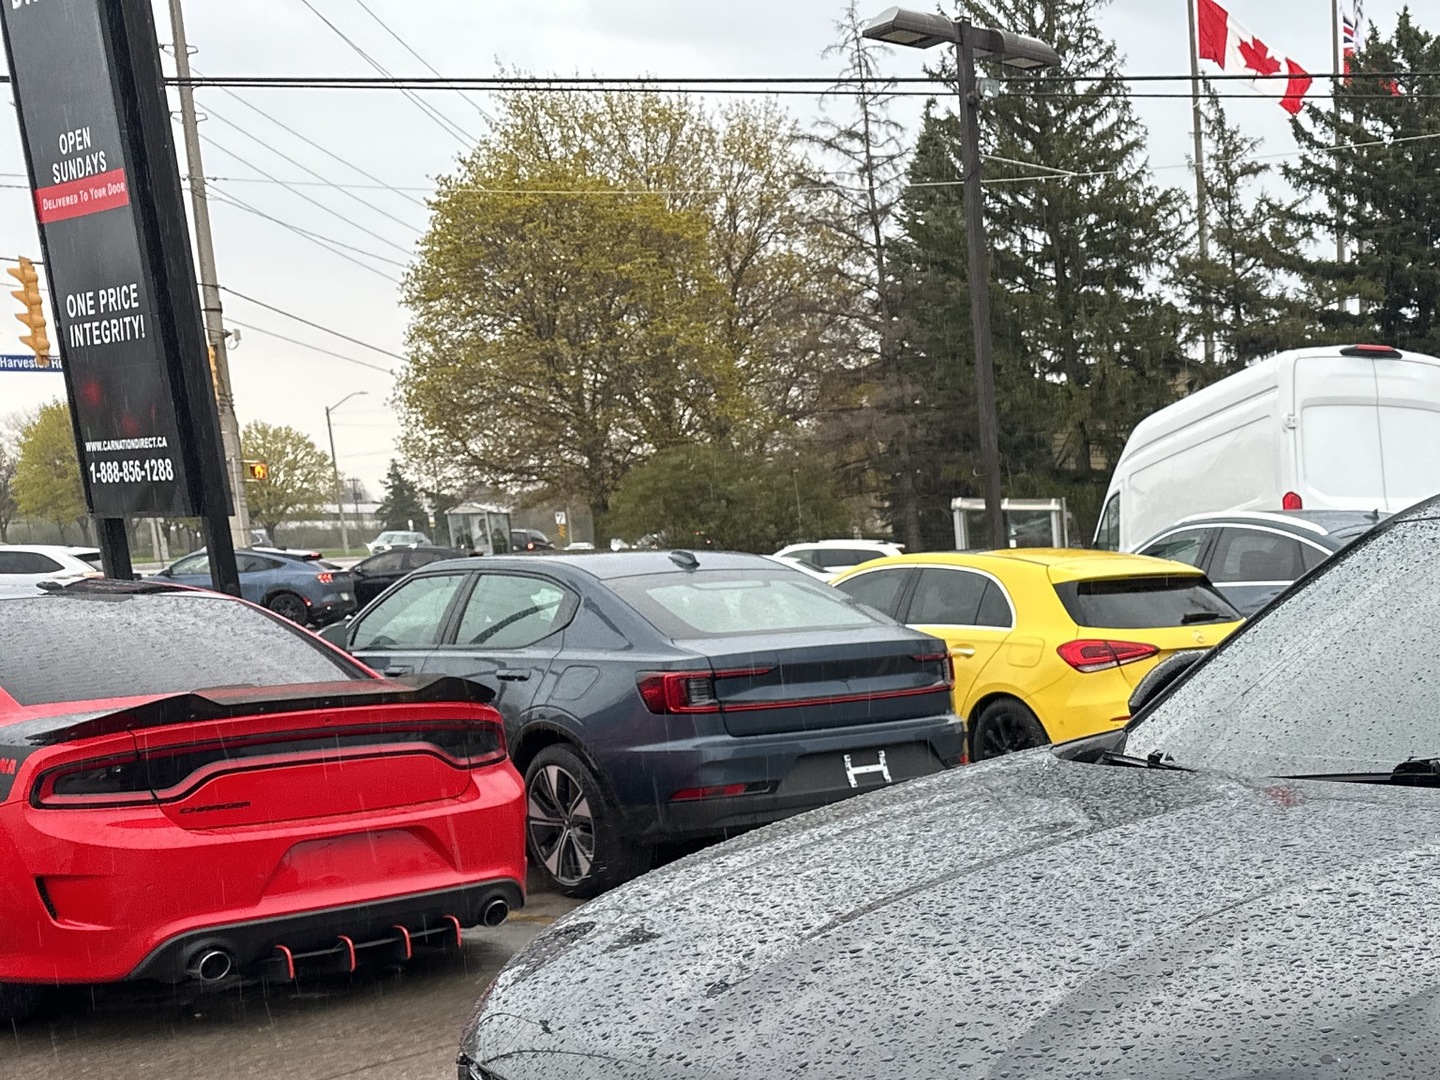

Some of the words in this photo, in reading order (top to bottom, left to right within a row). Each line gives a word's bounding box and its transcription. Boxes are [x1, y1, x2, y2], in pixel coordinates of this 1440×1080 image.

[59, 126, 91, 155] OPEN
[52, 150, 107, 184] SUNDAYS
[66, 291, 96, 318] ONE
[98, 283, 139, 314] PRICE
[69, 314, 146, 348] INTEGRITY!
[0, 356, 49, 369] Harvest
[90, 458, 174, 484] 1-888-856-1288
